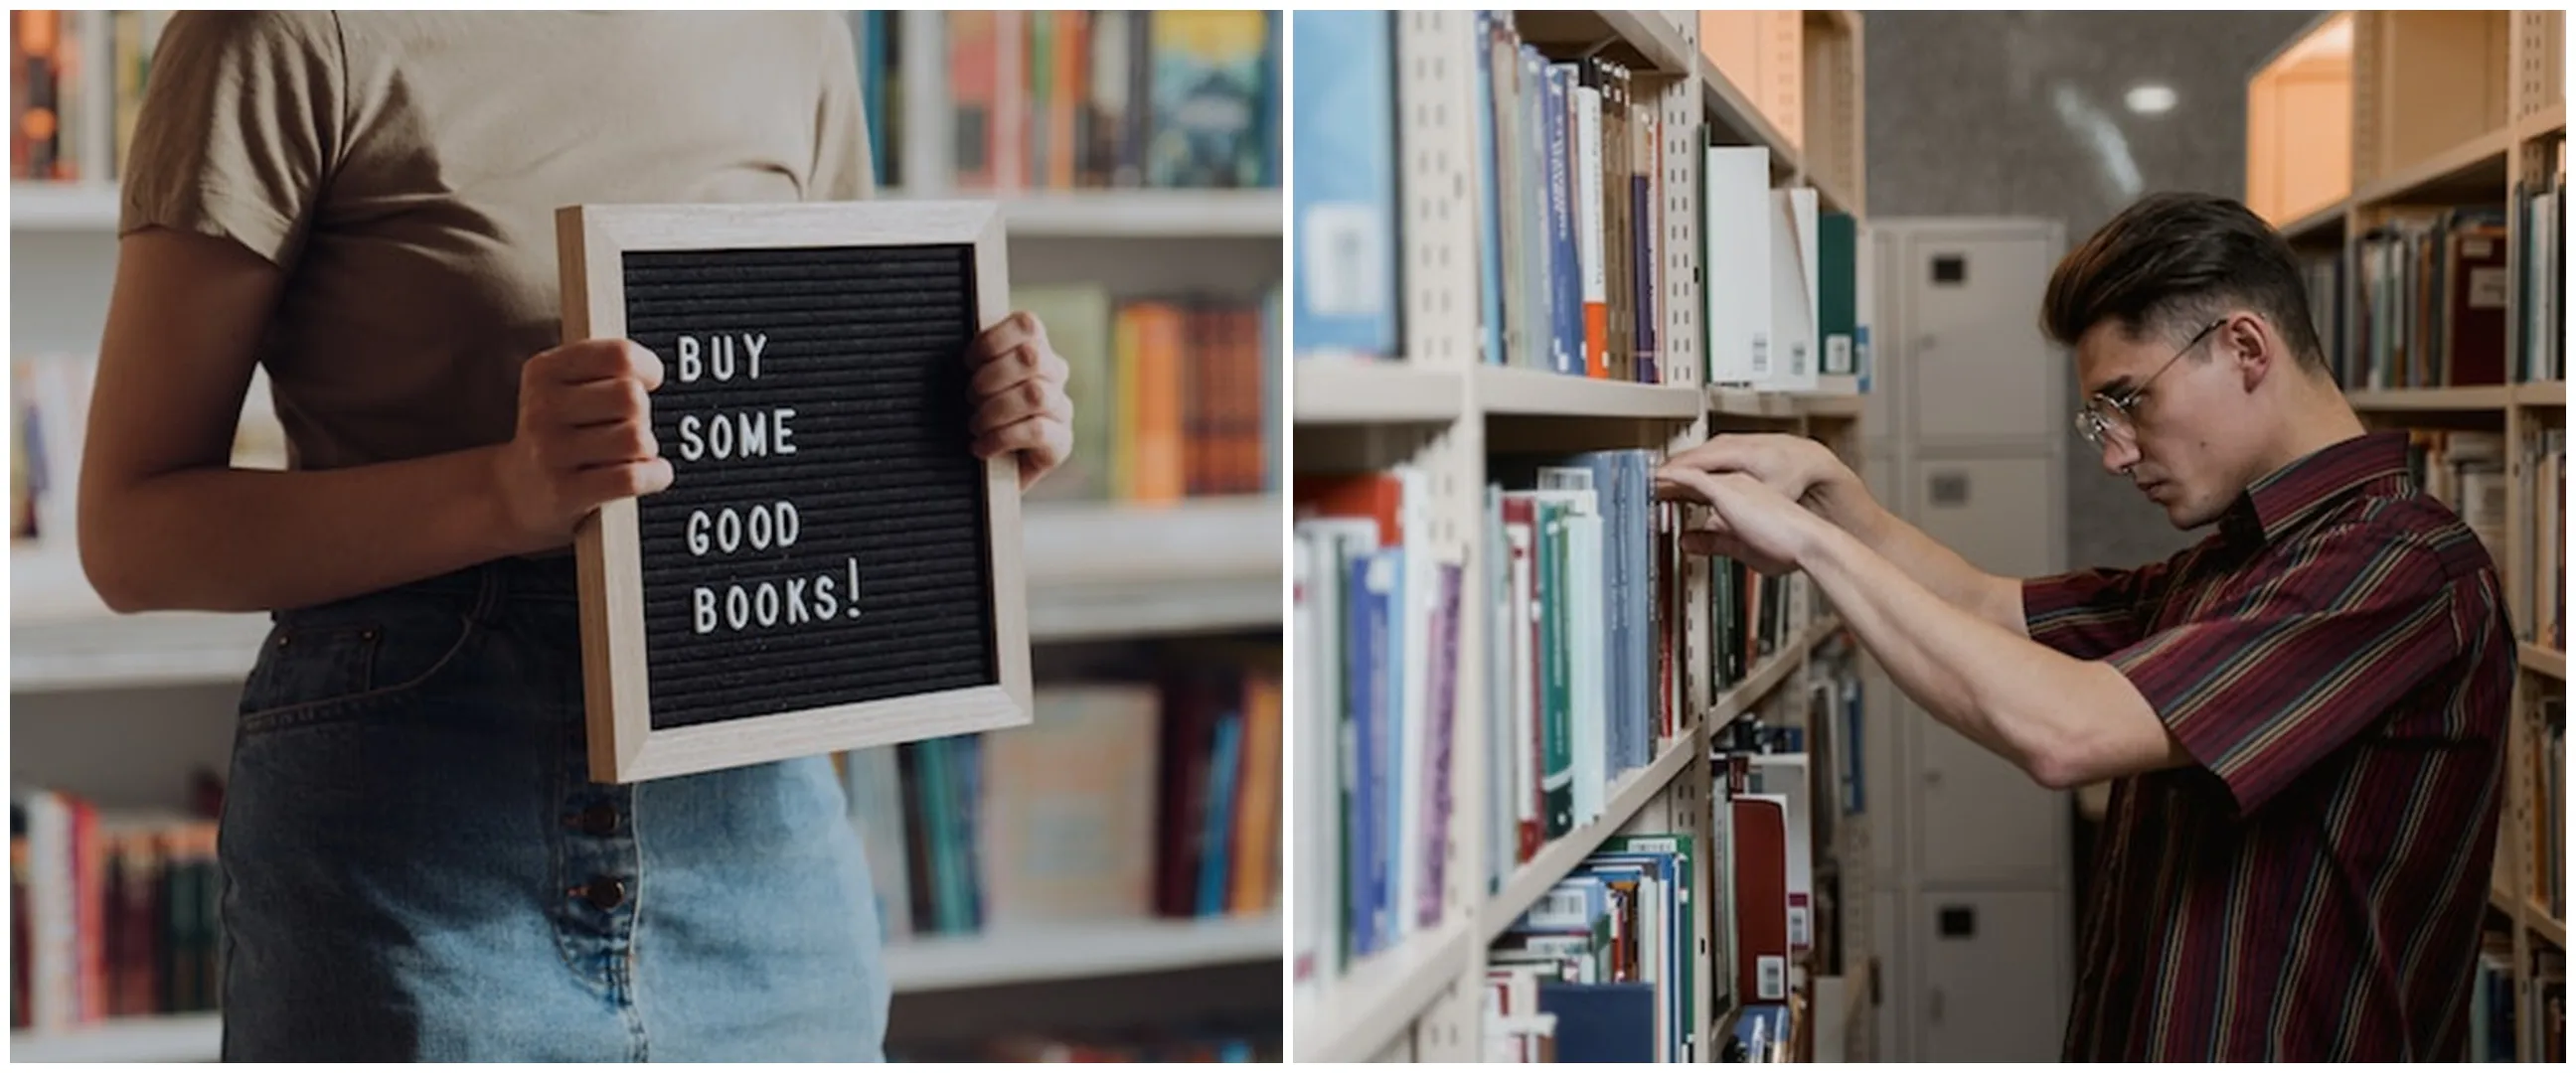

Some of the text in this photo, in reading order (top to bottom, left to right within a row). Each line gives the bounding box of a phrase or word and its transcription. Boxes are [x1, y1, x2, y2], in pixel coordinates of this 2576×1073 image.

[678, 333, 767, 382] BUY
[679, 408, 797, 460] SOME
[687, 501, 799, 555] GOOD
[694, 557, 861, 633] BOOKS!
